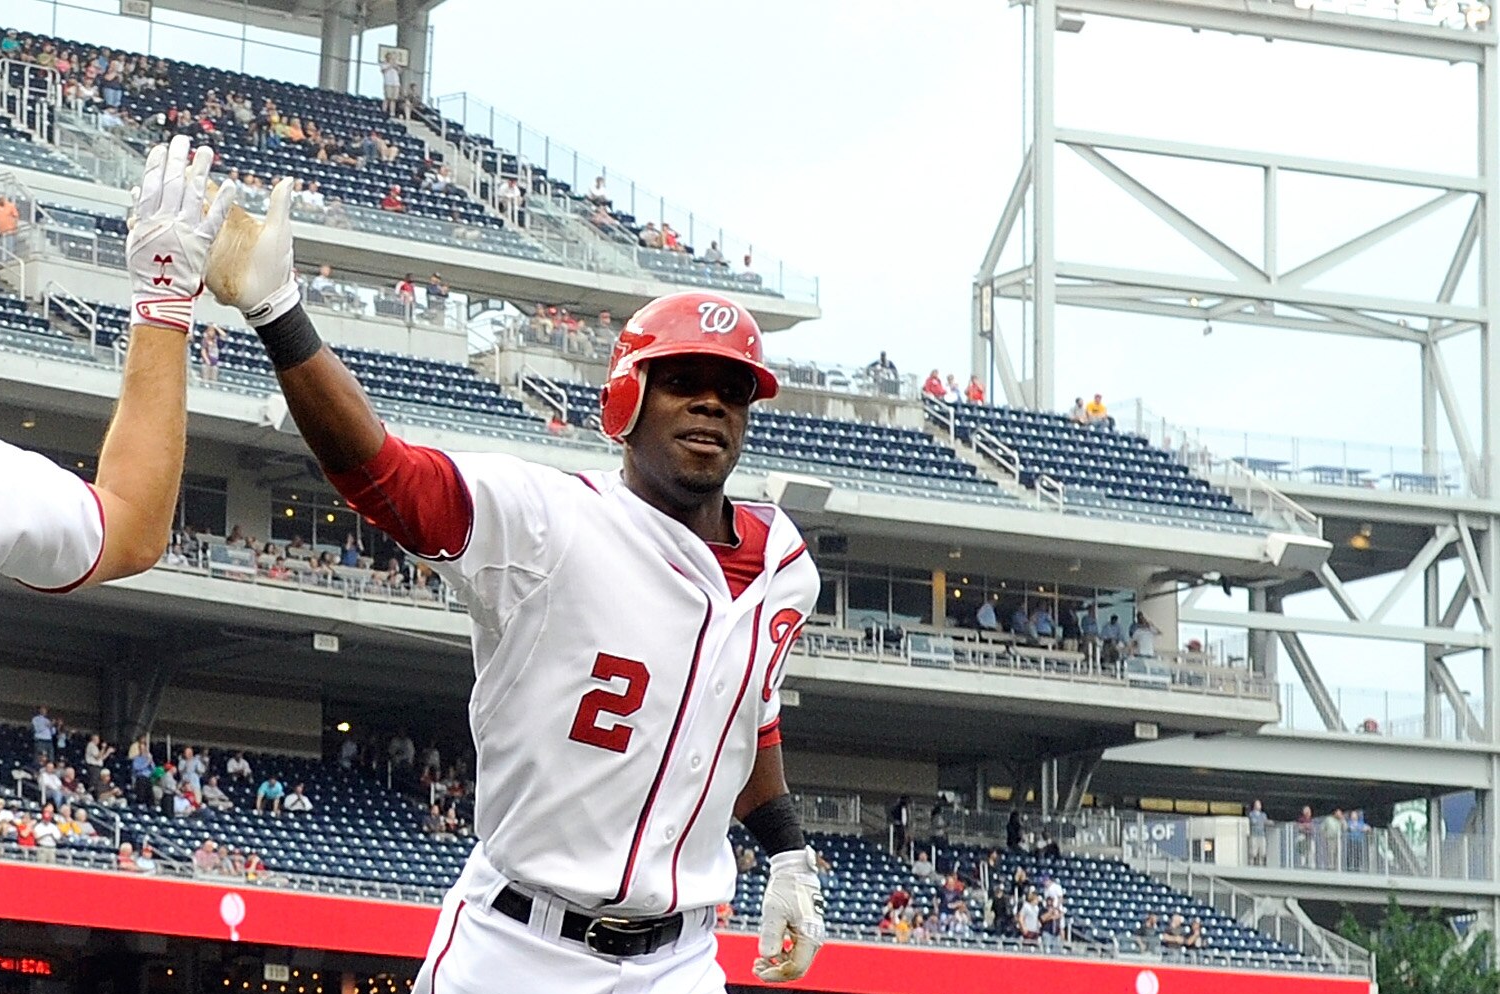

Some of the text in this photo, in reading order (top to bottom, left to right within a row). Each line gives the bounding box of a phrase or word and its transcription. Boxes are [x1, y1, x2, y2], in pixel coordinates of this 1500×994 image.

[698, 301, 739, 333] W
[568, 652, 650, 754] 2
[1151, 823, 1176, 840] OF
